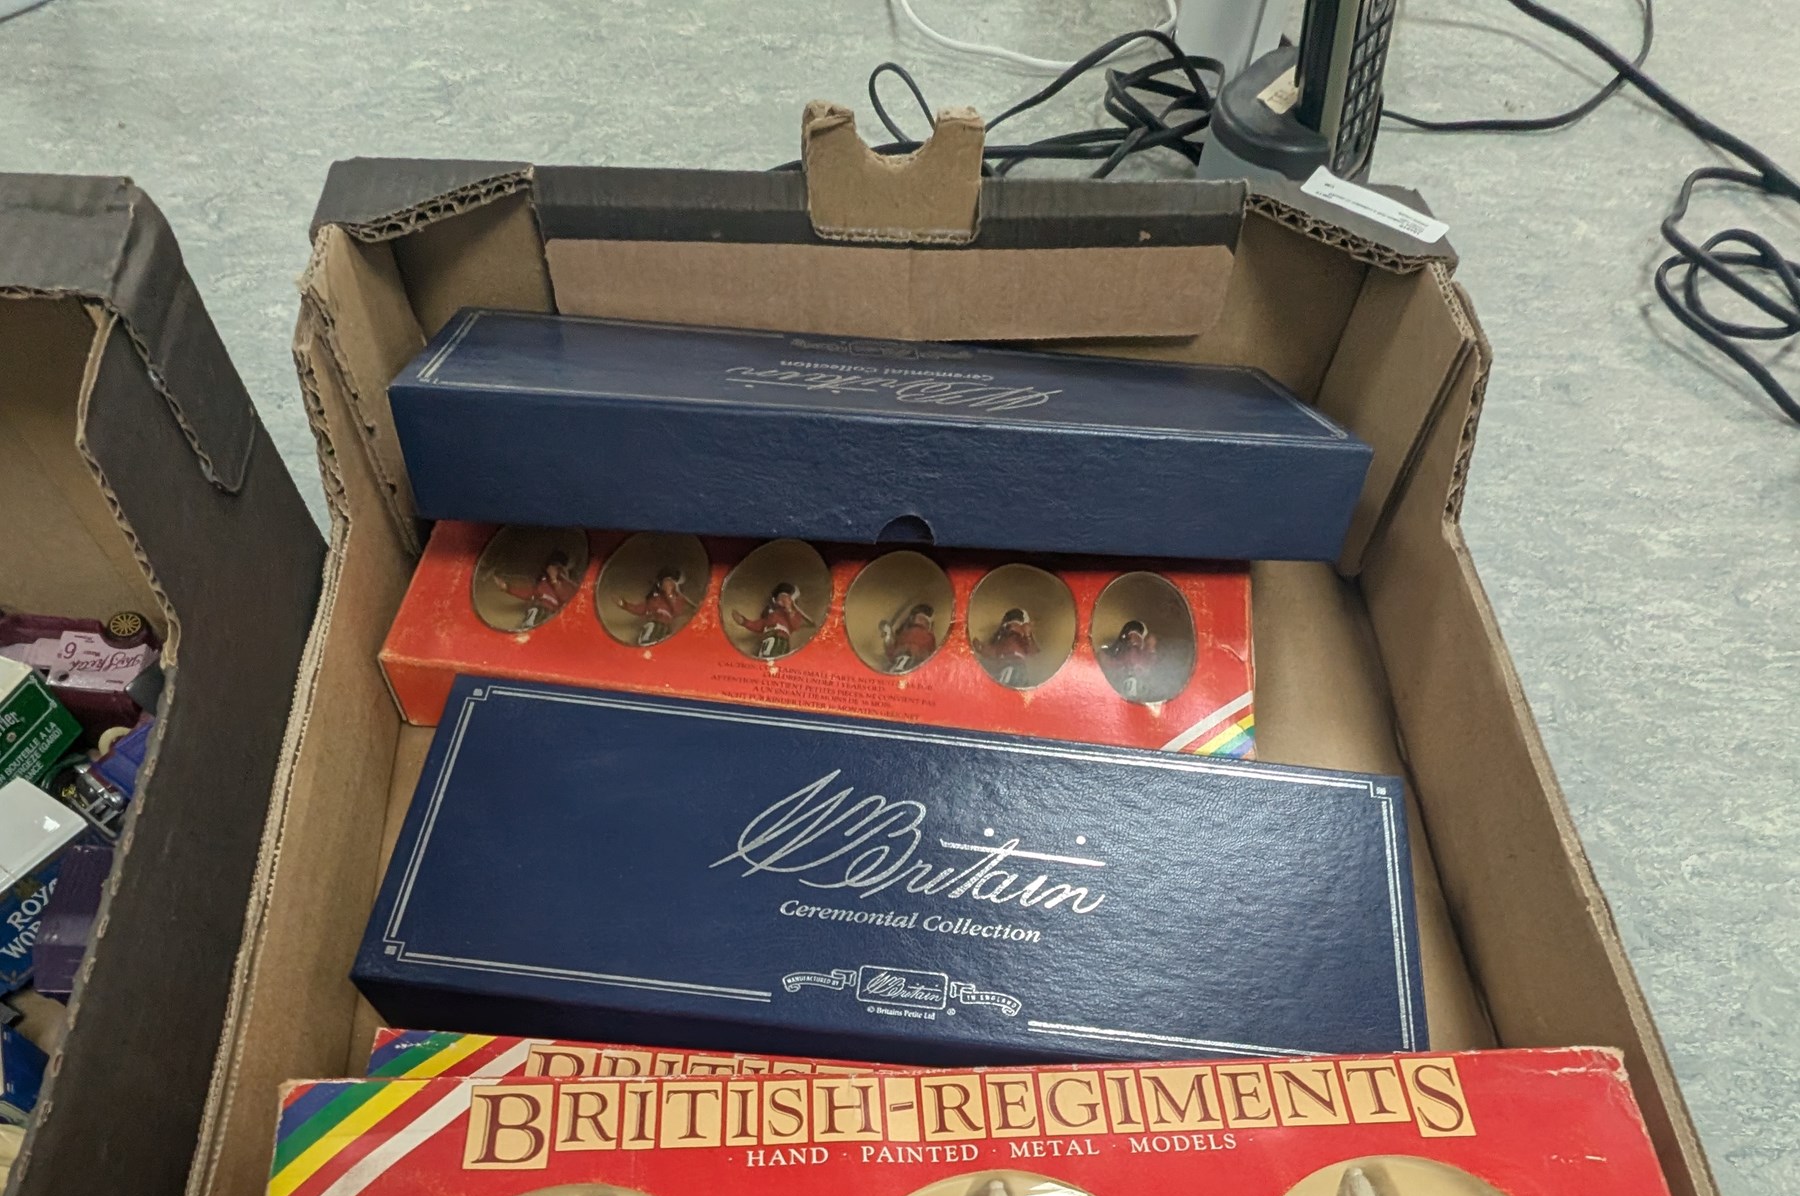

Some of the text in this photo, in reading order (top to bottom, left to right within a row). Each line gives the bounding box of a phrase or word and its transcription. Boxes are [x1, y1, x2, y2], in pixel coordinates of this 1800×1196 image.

[780, 360, 993, 381] Ceremonial Collection
[779, 899, 1041, 943] Ceremonial Collection
[876, 1007, 903, 1017] Britains
[903, 1010, 922, 1019] Petite
[923, 1012, 936, 1020] Ltd
[746, 1132, 1237, 1168] HAND PAINTED METAL MODELS
